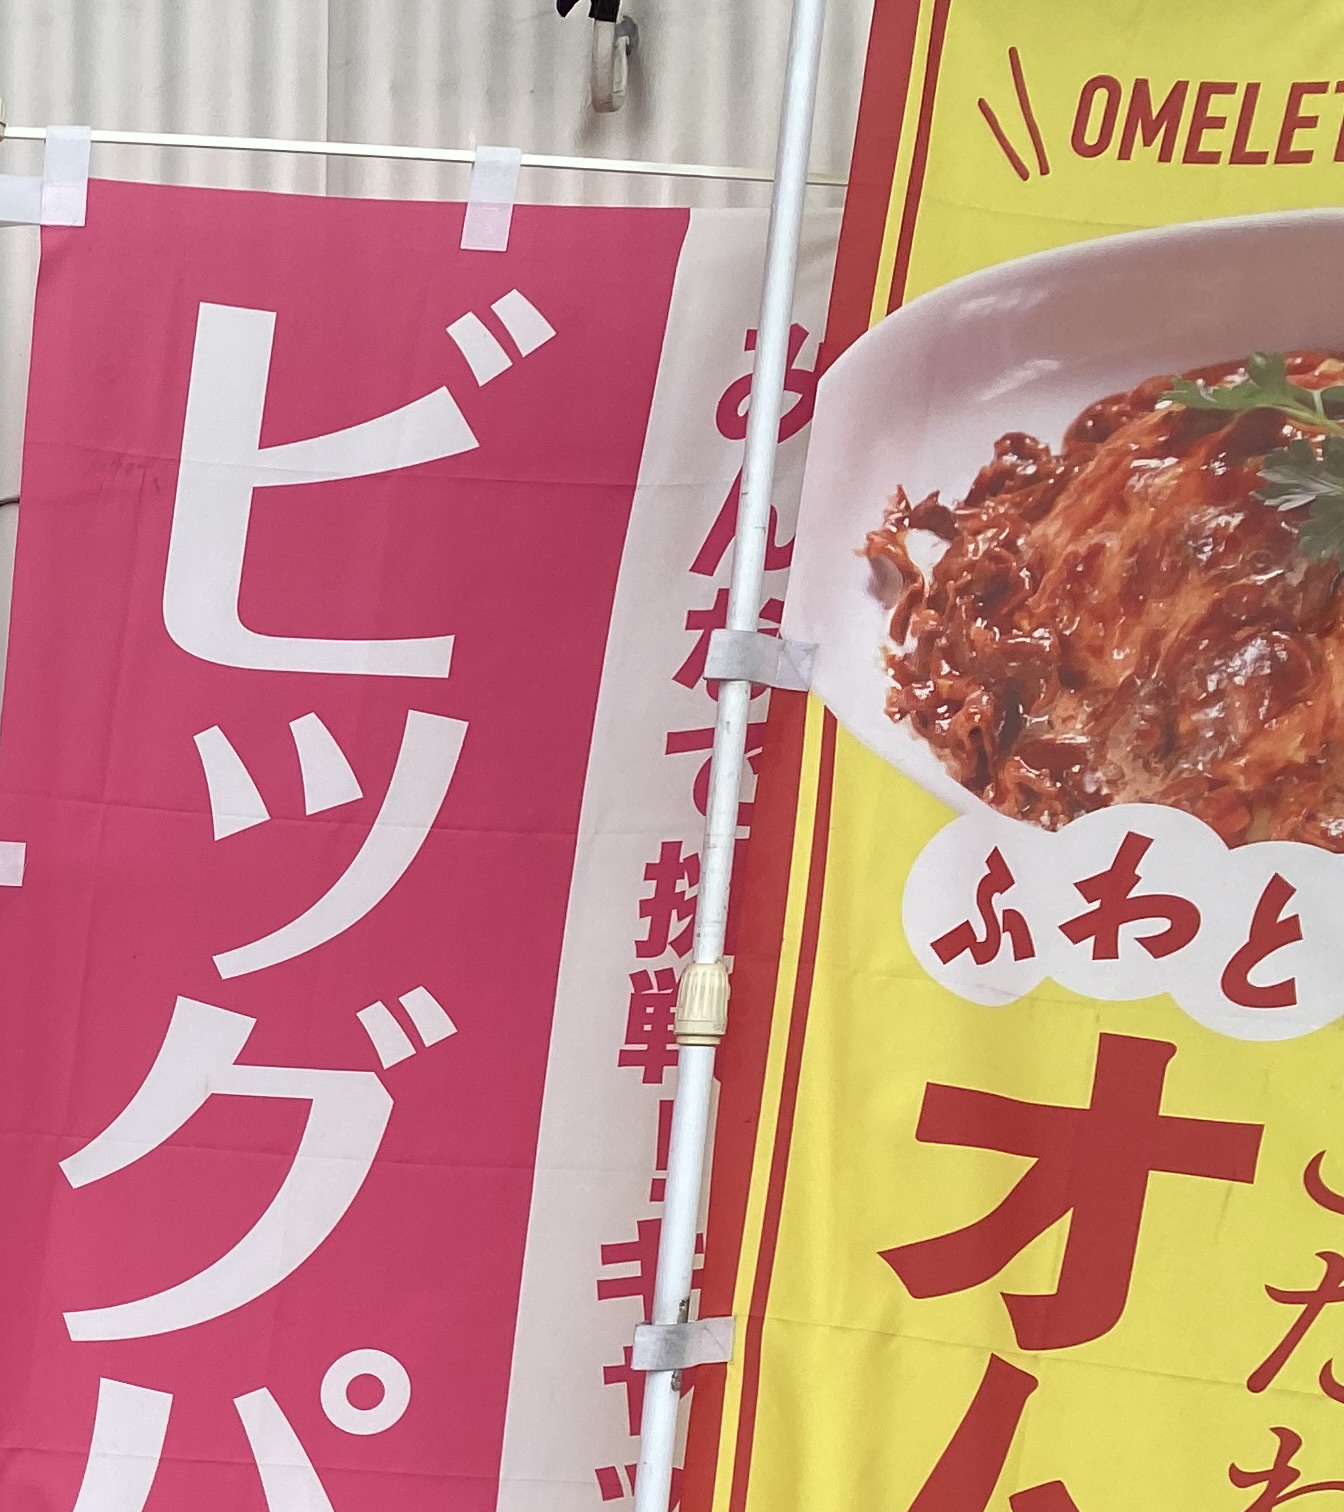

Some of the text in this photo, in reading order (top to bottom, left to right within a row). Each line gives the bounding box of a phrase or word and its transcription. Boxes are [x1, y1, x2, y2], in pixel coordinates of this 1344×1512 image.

[1070, 74, 1344, 165] OMELE
[929, 831, 1304, 1009] ふわと
